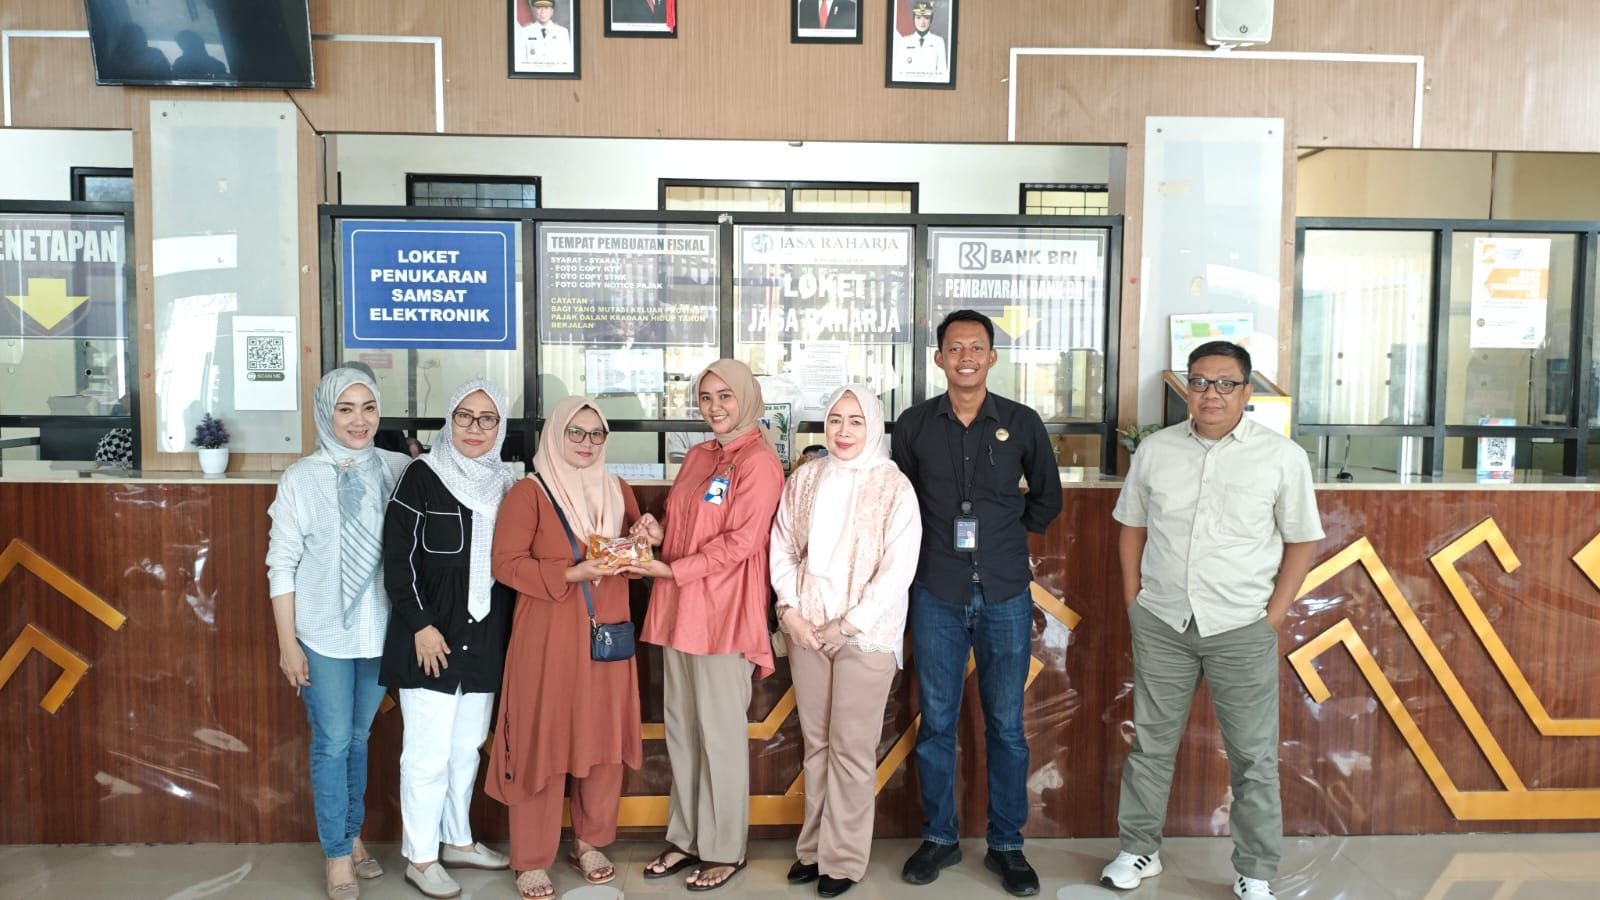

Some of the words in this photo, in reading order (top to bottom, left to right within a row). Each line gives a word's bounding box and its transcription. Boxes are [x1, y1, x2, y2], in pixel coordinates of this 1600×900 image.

[551, 236, 595, 249] TEMPAT
[599, 237, 665, 250] PEMBUATAN
[667, 238, 705, 251] FISKAL
[780, 236, 816, 249] JASA
[821, 237, 899, 252] RAHARJA
[397, 249, 459, 264] LOKET
[991, 249, 1041, 264] BANK
[1048, 250, 1077, 265] BRI
[370, 269, 487, 283] PENUKARAN
[555, 264, 577, 272] FOTO
[579, 265, 602, 273] COPY
[555, 272, 577, 280] FOTO
[579, 273, 602, 281] COPY
[579, 281, 602, 289] COPY
[784, 271, 865, 299] LOKET
[945, 279, 1027, 299] PEMBAYARAN
[391, 289, 467, 303] SAMSAT
[369, 308, 490, 323] ELEKTRONIK
[748, 308, 798, 332] JASA
